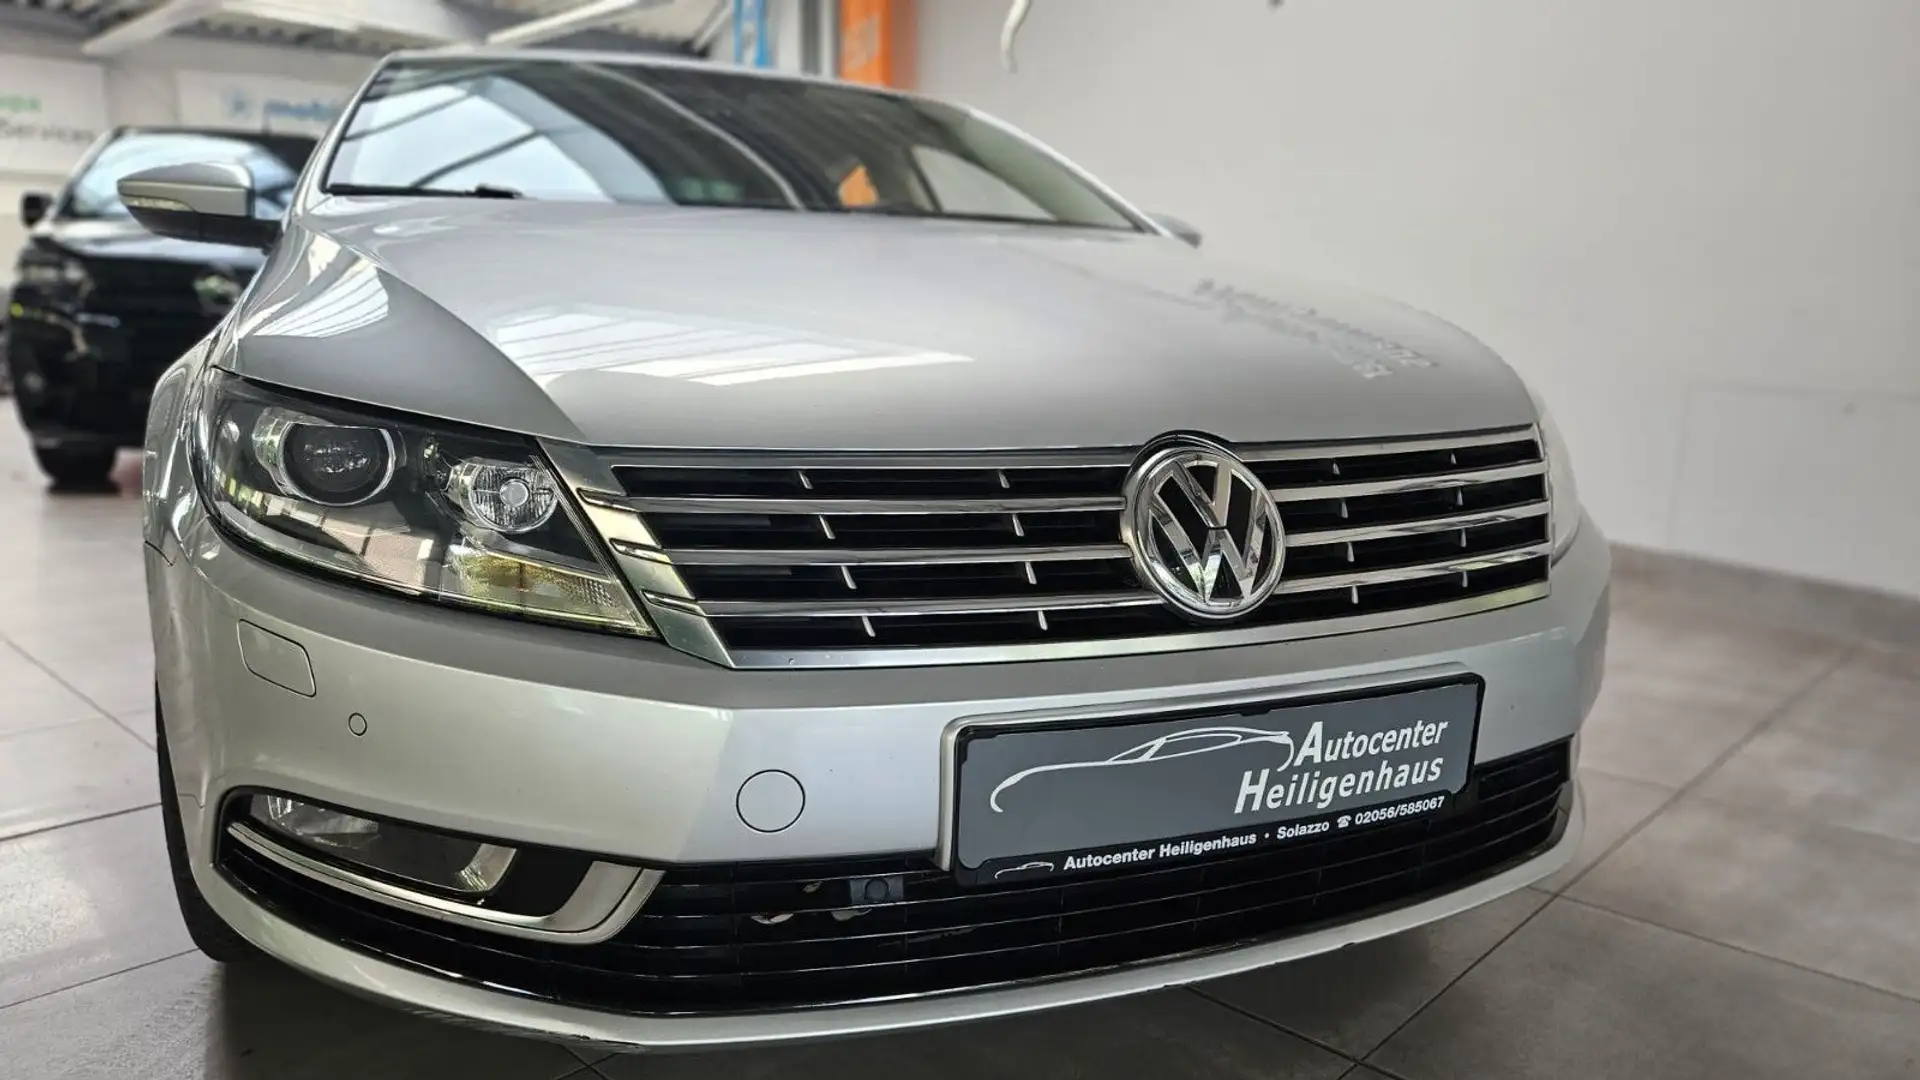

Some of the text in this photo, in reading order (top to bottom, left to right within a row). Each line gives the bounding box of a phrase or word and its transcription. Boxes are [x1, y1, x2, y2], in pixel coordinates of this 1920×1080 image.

[1144, 450, 1272, 602] VW
[1293, 720, 1448, 767] Autocenter
[1234, 757, 1444, 814] Heiligenhaus
[1063, 796, 1445, 871] Autocenter Heiligenhaus Solazzo 02056/585067
